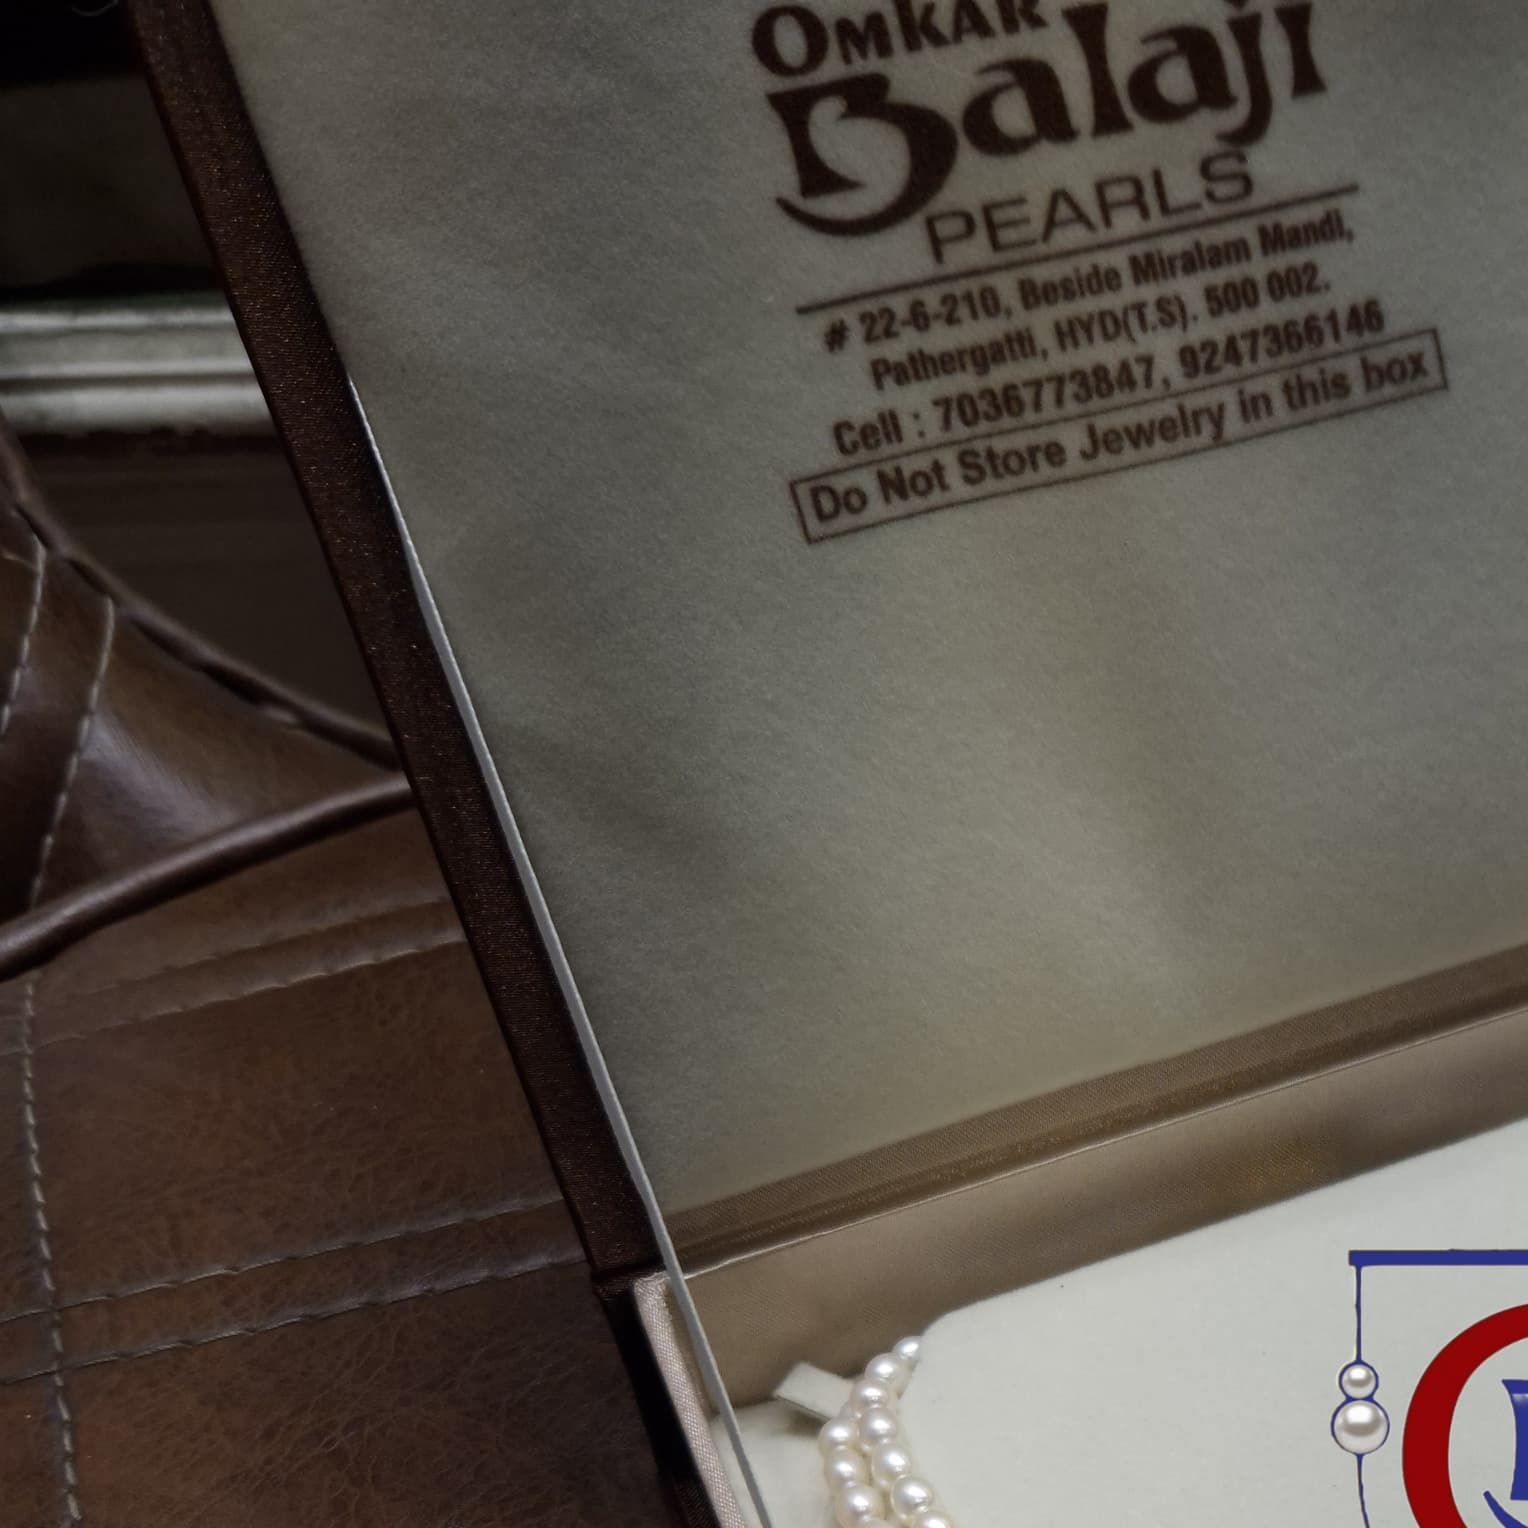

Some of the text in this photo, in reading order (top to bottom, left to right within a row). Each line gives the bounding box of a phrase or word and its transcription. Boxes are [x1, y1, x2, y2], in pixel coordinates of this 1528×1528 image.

[924, 149, 1254, 265] PEARLS
[1017, 262, 1123, 311] Beside
[1128, 236, 1252, 286] Miralam
[1257, 207, 1354, 257] Mandi,
[833, 408, 904, 455] Cell
[933, 353, 1171, 433] 7036773847,
[1178, 298, 1385, 380] 9247366146
[870, 327, 1049, 390] Pathergatti,
[1204, 276, 1261, 318] 500
[1266, 260, 1331, 302] 002.
[809, 351, 1428, 522] Do Not Store Jewelry in this box
